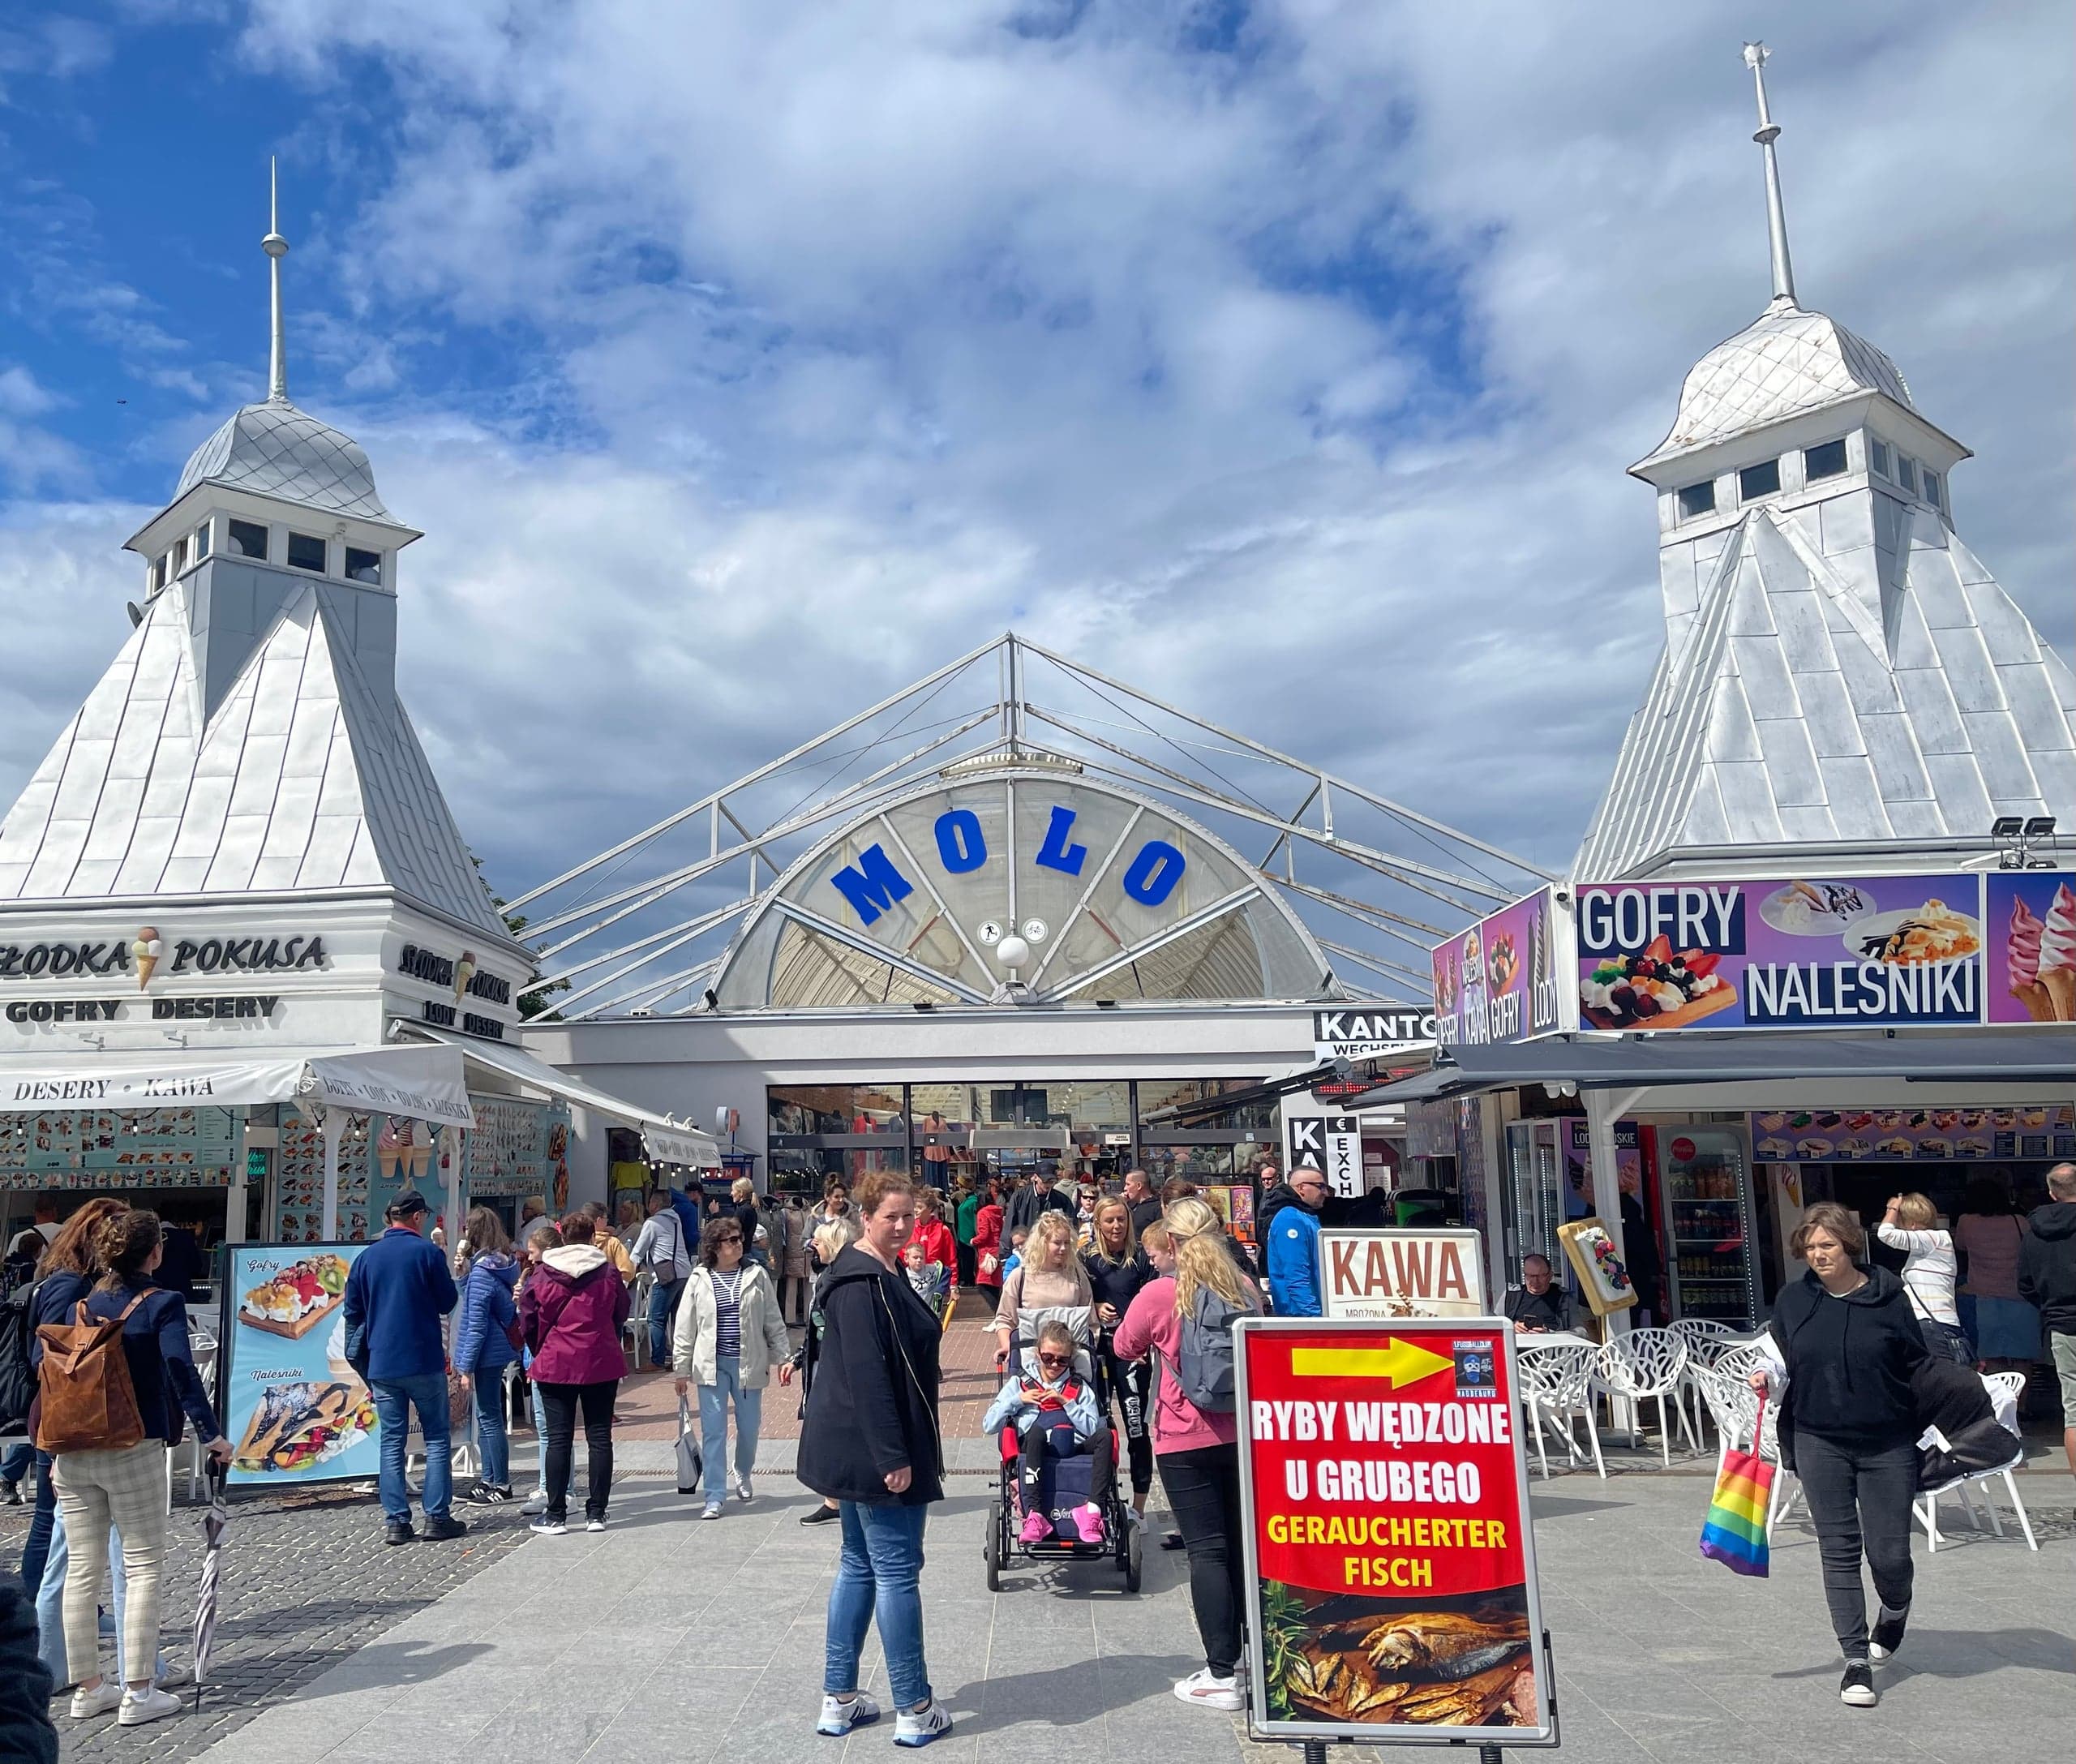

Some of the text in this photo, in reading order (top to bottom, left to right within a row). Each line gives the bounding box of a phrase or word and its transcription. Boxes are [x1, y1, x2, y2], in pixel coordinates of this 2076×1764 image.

[830, 805, 1186, 926] MOLO
[1582, 886, 1740, 950] GOFRY
[171, 937, 326, 972] POKUSA
[1748, 946, 1975, 1016] NALEŚNIKI
[6, 995, 280, 1023] GOFRY DESERY
[425, 1000, 457, 1026] LODY
[1491, 990, 1520, 1039] GOFRY
[1534, 976, 1557, 1028] LODY
[463, 1012, 504, 1039] DESERY
[1437, 1012, 1460, 1045] DESERY
[13, 1077, 215, 1101] DESERY KAWA
[1336, 1118, 1346, 1130] €
[1574, 1132, 1590, 1144] LOD
[247, 1260, 279, 1273] Gofry
[1332, 1241, 1469, 1298] KAWA
[1252, 1401, 1511, 1449] RYBY WĘDZONE
[1285, 1460, 1481, 1504] U GRUBEGO
[1267, 1515, 1507, 1548] GERAUCHERTER
[1345, 1557, 1433, 1587] FISCH
